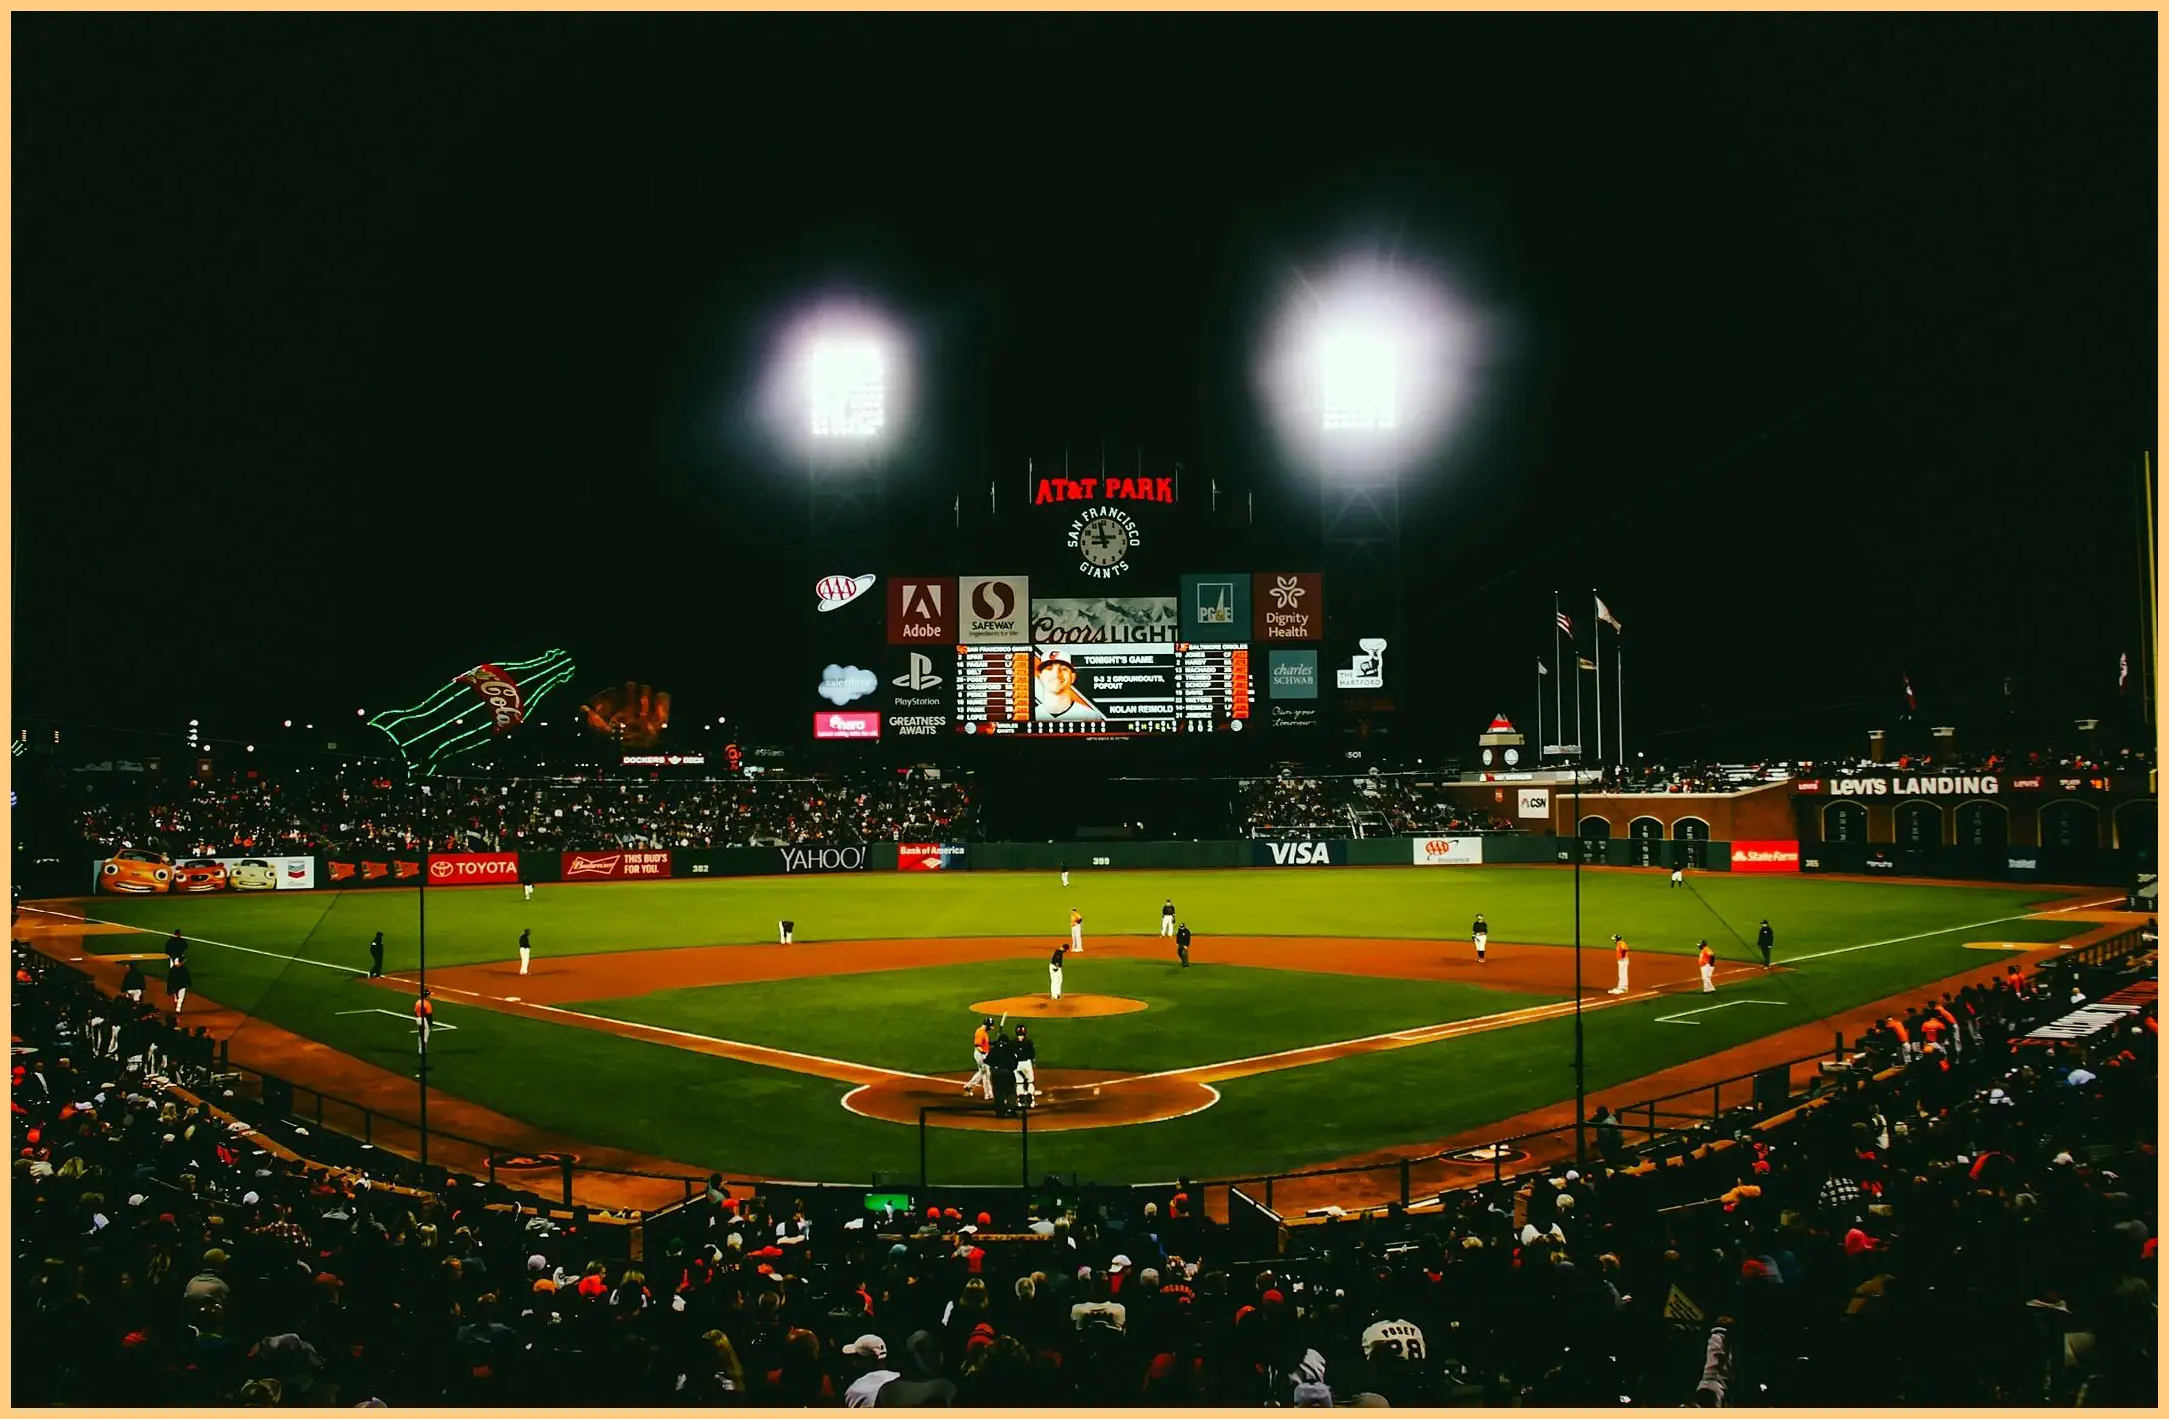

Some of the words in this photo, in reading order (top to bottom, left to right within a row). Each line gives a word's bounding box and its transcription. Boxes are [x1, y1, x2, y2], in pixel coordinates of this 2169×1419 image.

[1035, 478, 1098, 505] AT&T
[1105, 478, 1172, 503] PARK
[1068, 520, 1083, 548] SAN
[1081, 506, 1140, 547] FRANCISCO
[1080, 561, 1130, 579] GIANTS
[819, 577, 856, 601] AAA
[1200, 607, 1231, 621] PG&E
[1266, 612, 1309, 627] Dignity
[902, 624, 942, 638] Adobe
[972, 621, 1015, 630] SAFEWAY
[1032, 617, 1108, 643] Coors
[1111, 625, 1178, 642] LIGHT
[1269, 626, 1308, 637] Health
[1084, 656, 1128, 664] TONIGHT'S
[1273, 663, 1313, 675] charles
[1113, 675, 1165, 683] GROUNDOUTS,
[1273, 677, 1314, 685] SCHWAB
[894, 698, 940, 708] PlayStation
[1109, 705, 1137, 713] NOLAN
[1138, 705, 1174, 713] REIMOLD
[889, 716, 946, 726] GREATNESS
[899, 726, 937, 735] AWAITS
[623, 756, 665, 764] DOCKERS
[1892, 776, 1999, 795] LANDING
[1530, 798, 1547, 808] CSN
[899, 846, 921, 855] Bank
[922, 846, 930, 855] of
[930, 846, 965, 855] America
[1266, 842, 1332, 865] VISA
[624, 854, 642, 863] THIS
[643, 854, 668, 863] BUD'S
[780, 846, 867, 872] YAHOO!
[456, 861, 517, 874] TOYOTA
[624, 865, 640, 874] FOR
[641, 864, 660, 873] YOU.
[692, 864, 709, 873] 382
[1381, 1326, 1416, 1338] POSEY
